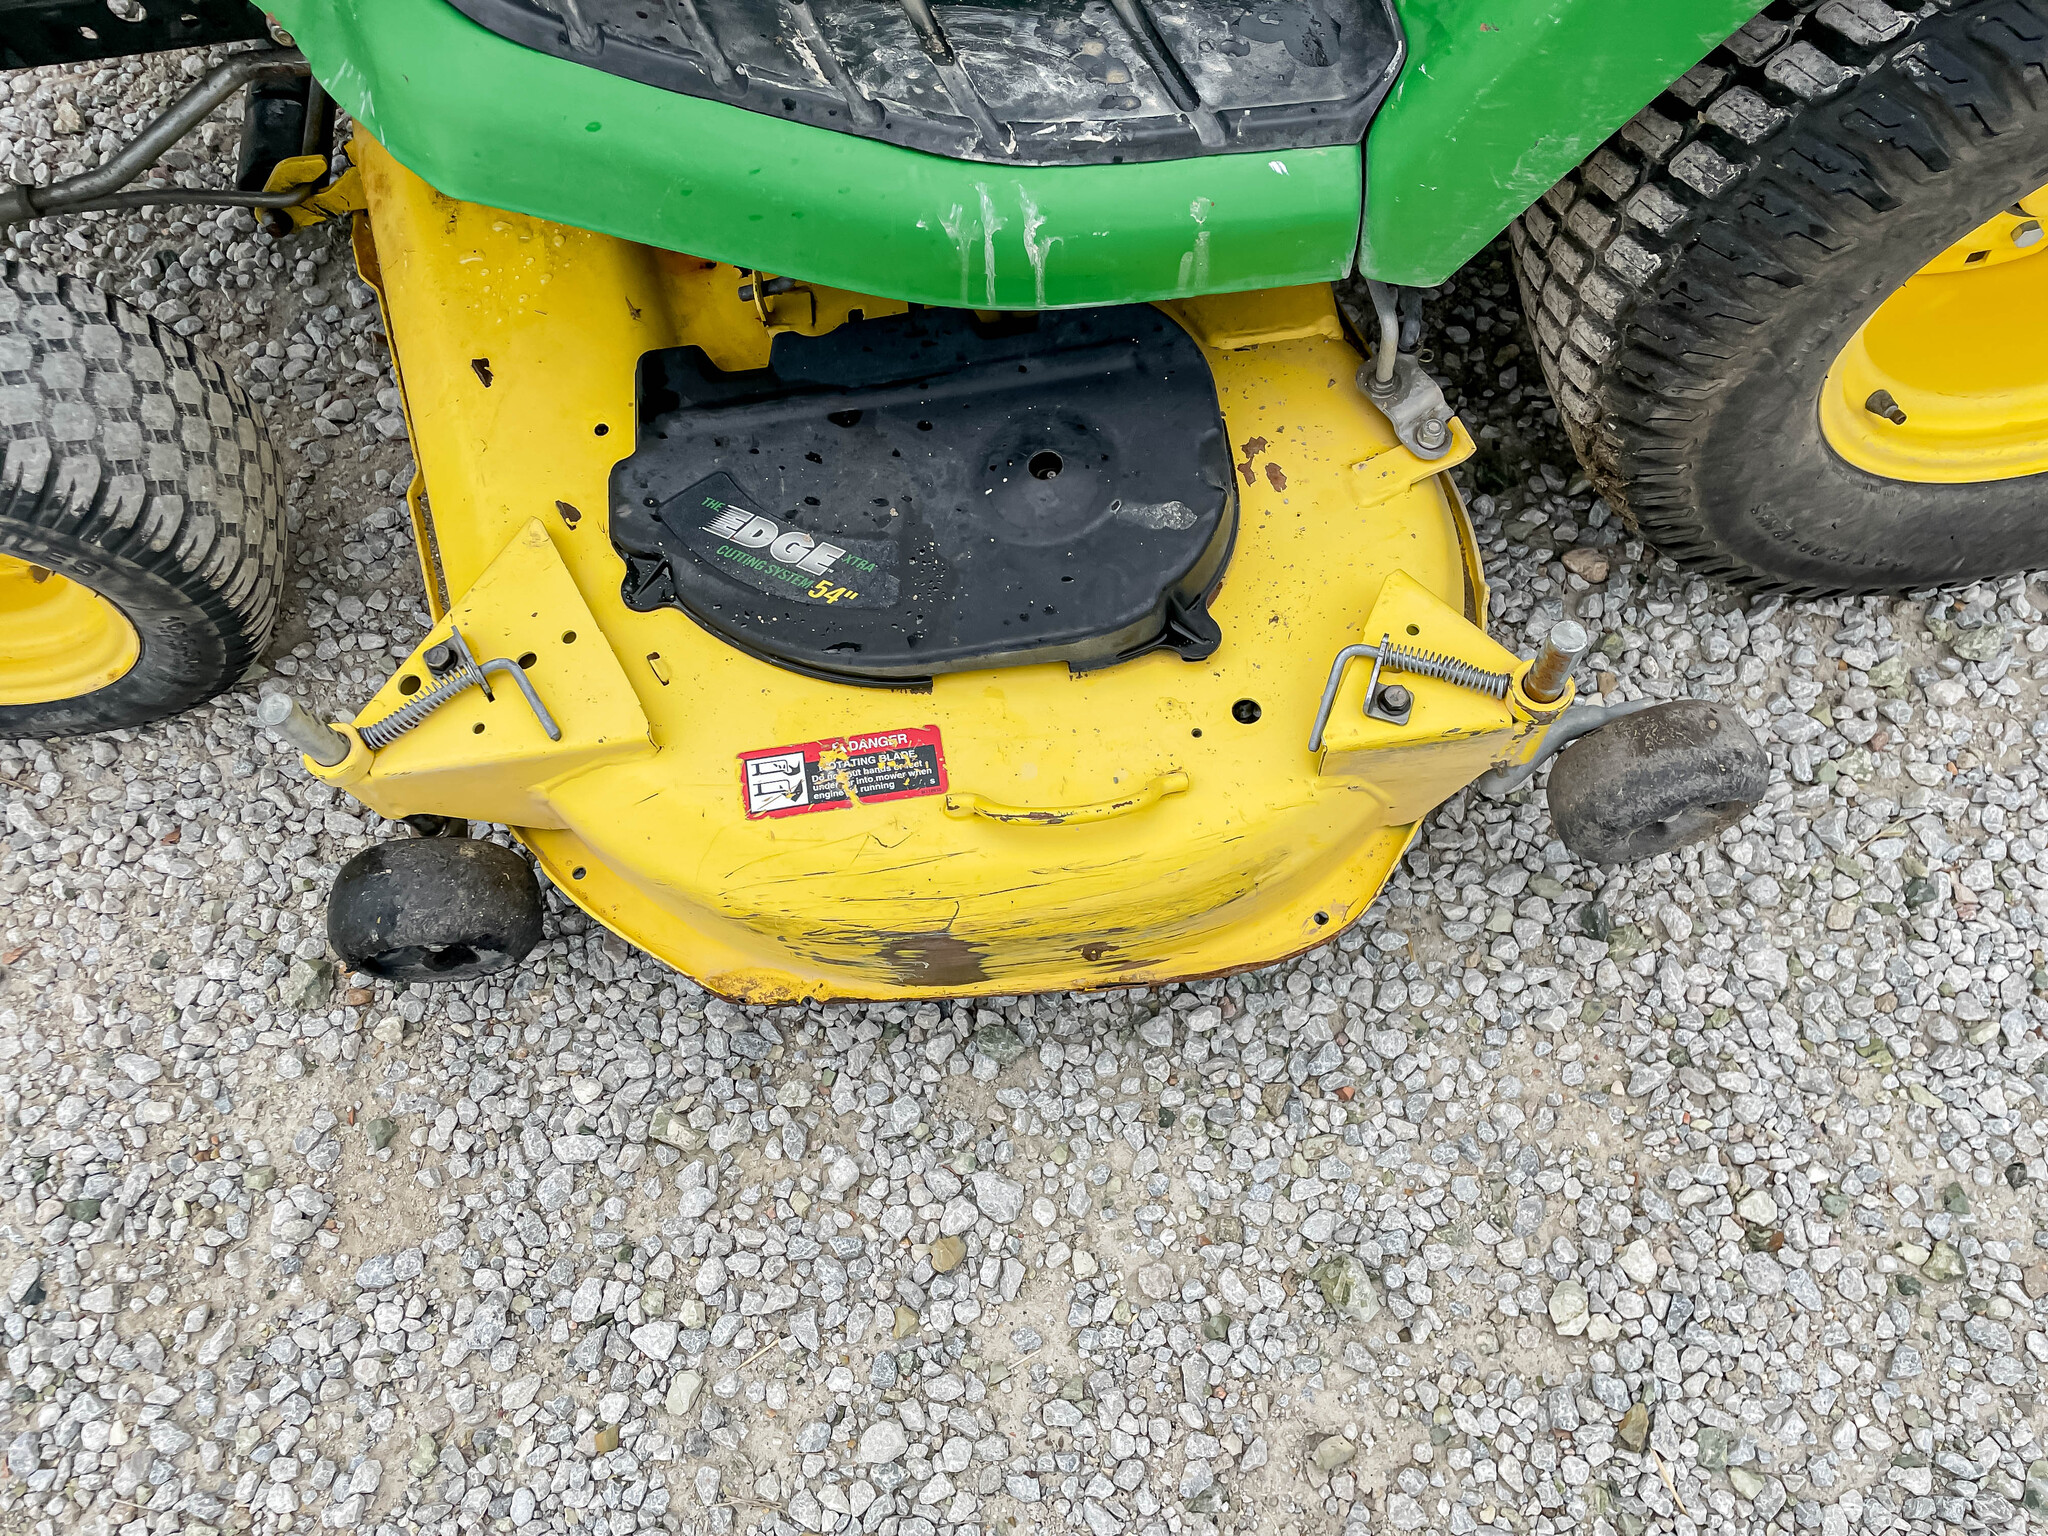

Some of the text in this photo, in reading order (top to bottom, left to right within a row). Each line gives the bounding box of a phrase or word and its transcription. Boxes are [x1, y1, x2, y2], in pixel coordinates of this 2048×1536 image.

[701, 497, 726, 512] THE
[702, 504, 847, 576] EDGE
[842, 554, 876, 573] XTRA
[717, 545, 815, 589] CUTTING SYSTEM
[808, 579, 859, 604] 54"
[848, 733, 908, 752] DANGER
[811, 773, 825, 783] Do
[856, 775, 874, 785] into
[875, 772, 906, 782] mower
[813, 789, 845, 800] engine
[860, 781, 895, 793] running
